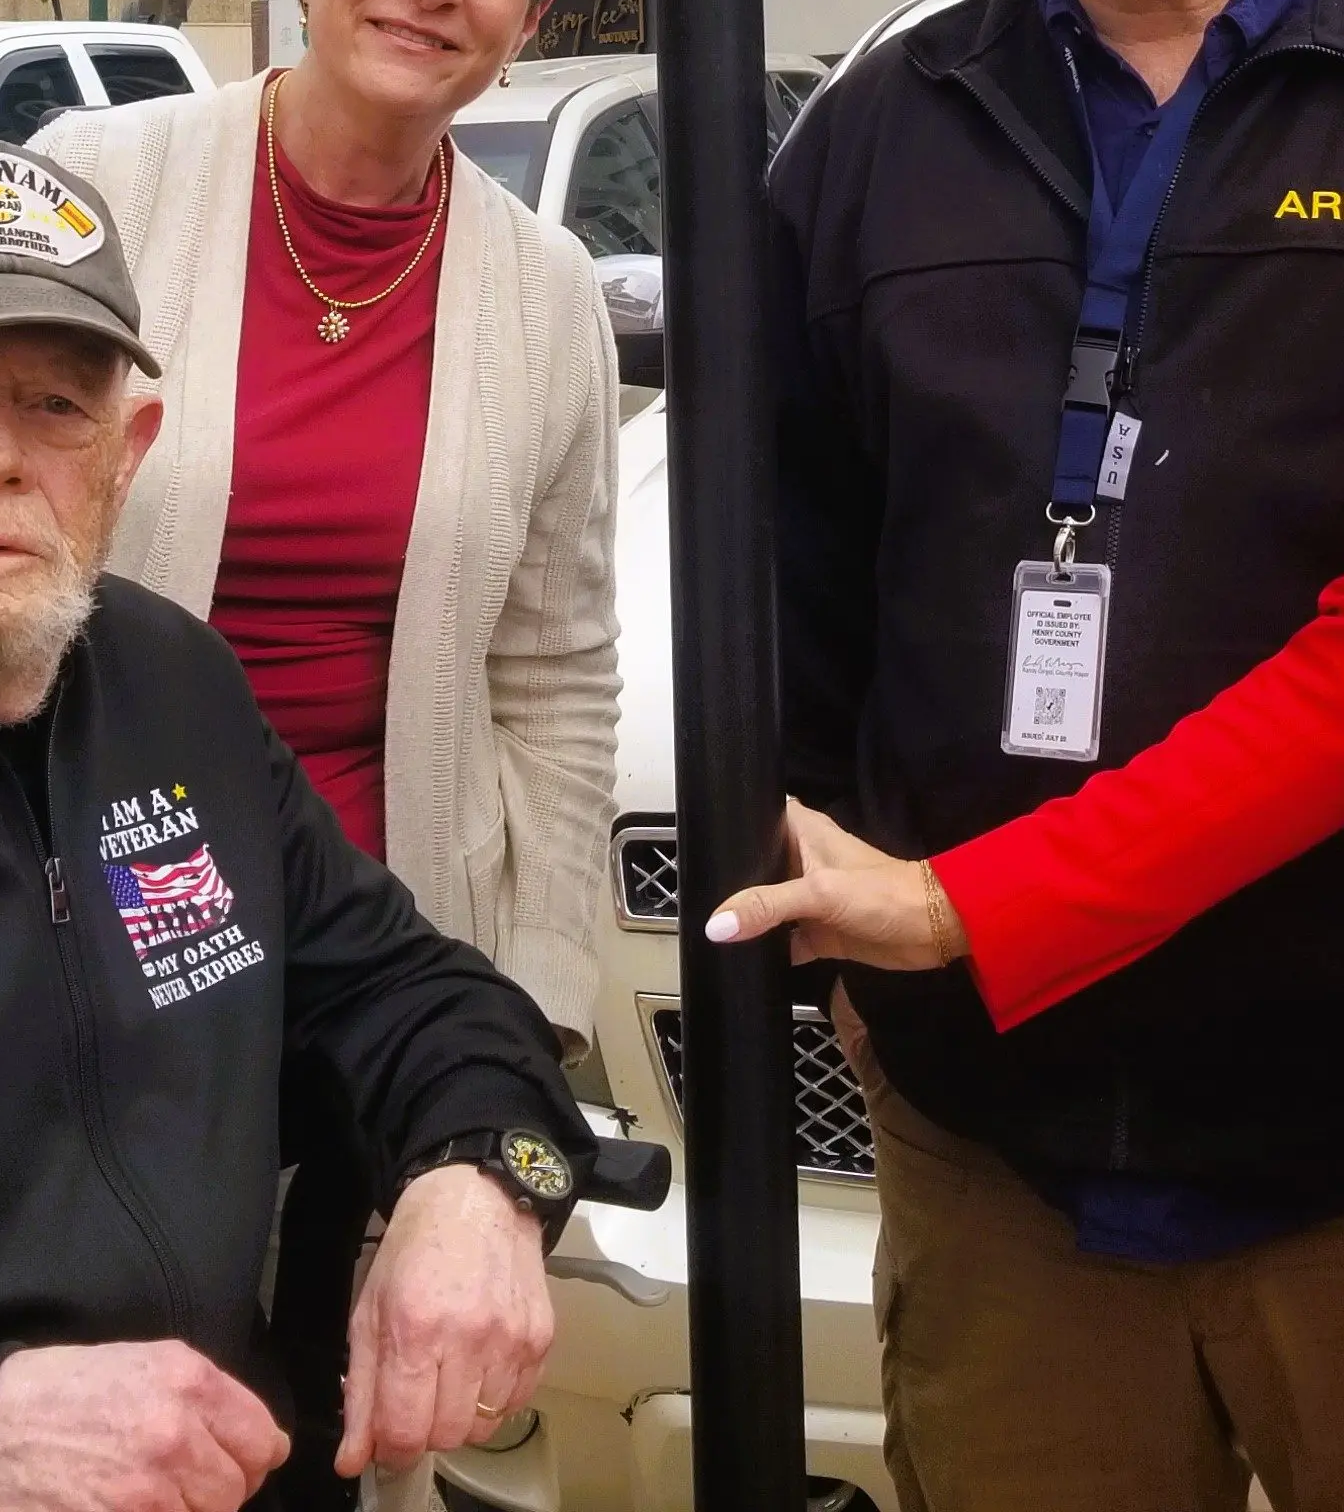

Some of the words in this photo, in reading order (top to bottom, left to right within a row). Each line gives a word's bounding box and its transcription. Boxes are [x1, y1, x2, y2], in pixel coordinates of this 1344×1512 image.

[0, 236, 59, 256] BROTHERS
[1026, 610, 1055, 619] OFFICIAL
[1056, 612, 1092, 621] EMPLOYEE
[1044, 621, 1068, 629] ISSUED
[1031, 629, 1054, 637] HENRY
[1055, 630, 1083, 638] COUNTY
[1034, 638, 1080, 647] GOVERNMENT
[101, 814, 108, 831] I
[111, 796, 146, 828] AM
[149, 788, 173, 816] A
[98, 807, 200, 861] VETERAN
[155, 952, 181, 977] MY
[183, 924, 245, 966] OATH
[147, 976, 191, 1010] NEVER
[188, 940, 265, 993] EXPIRES
